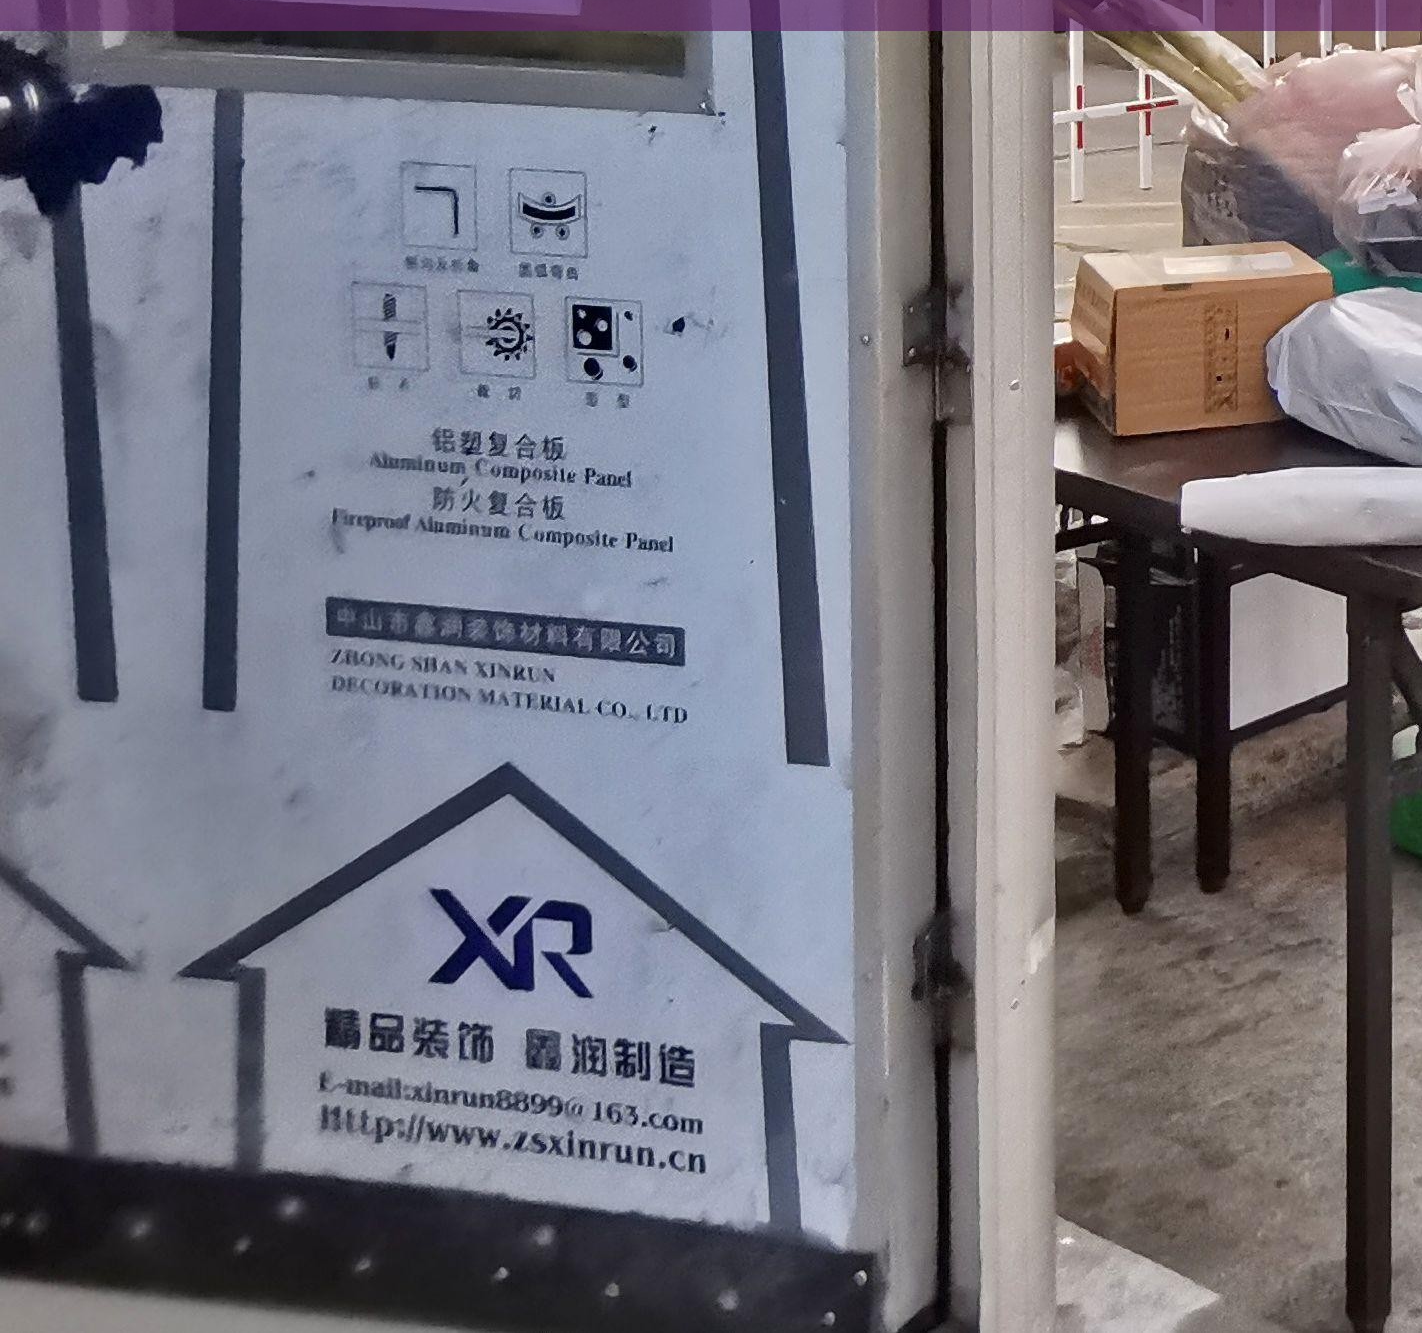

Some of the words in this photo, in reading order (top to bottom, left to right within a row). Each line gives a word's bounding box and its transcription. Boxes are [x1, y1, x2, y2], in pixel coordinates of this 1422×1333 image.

[431, 426, 567, 462] 铝塑复合板
[369, 450, 466, 475] Aluminum
[474, 456, 576, 485] Composite
[584, 467, 632, 488] Panel
[432, 486, 567, 521] 防火复合板
[414, 516, 511, 539] Aluminum
[518, 523, 619, 549] Composite
[624, 532, 675, 553] Panel
[474, 659, 556, 683] XINRUN
[331, 675, 471, 703] DECORATION
[479, 687, 590, 715] MATERIAL
